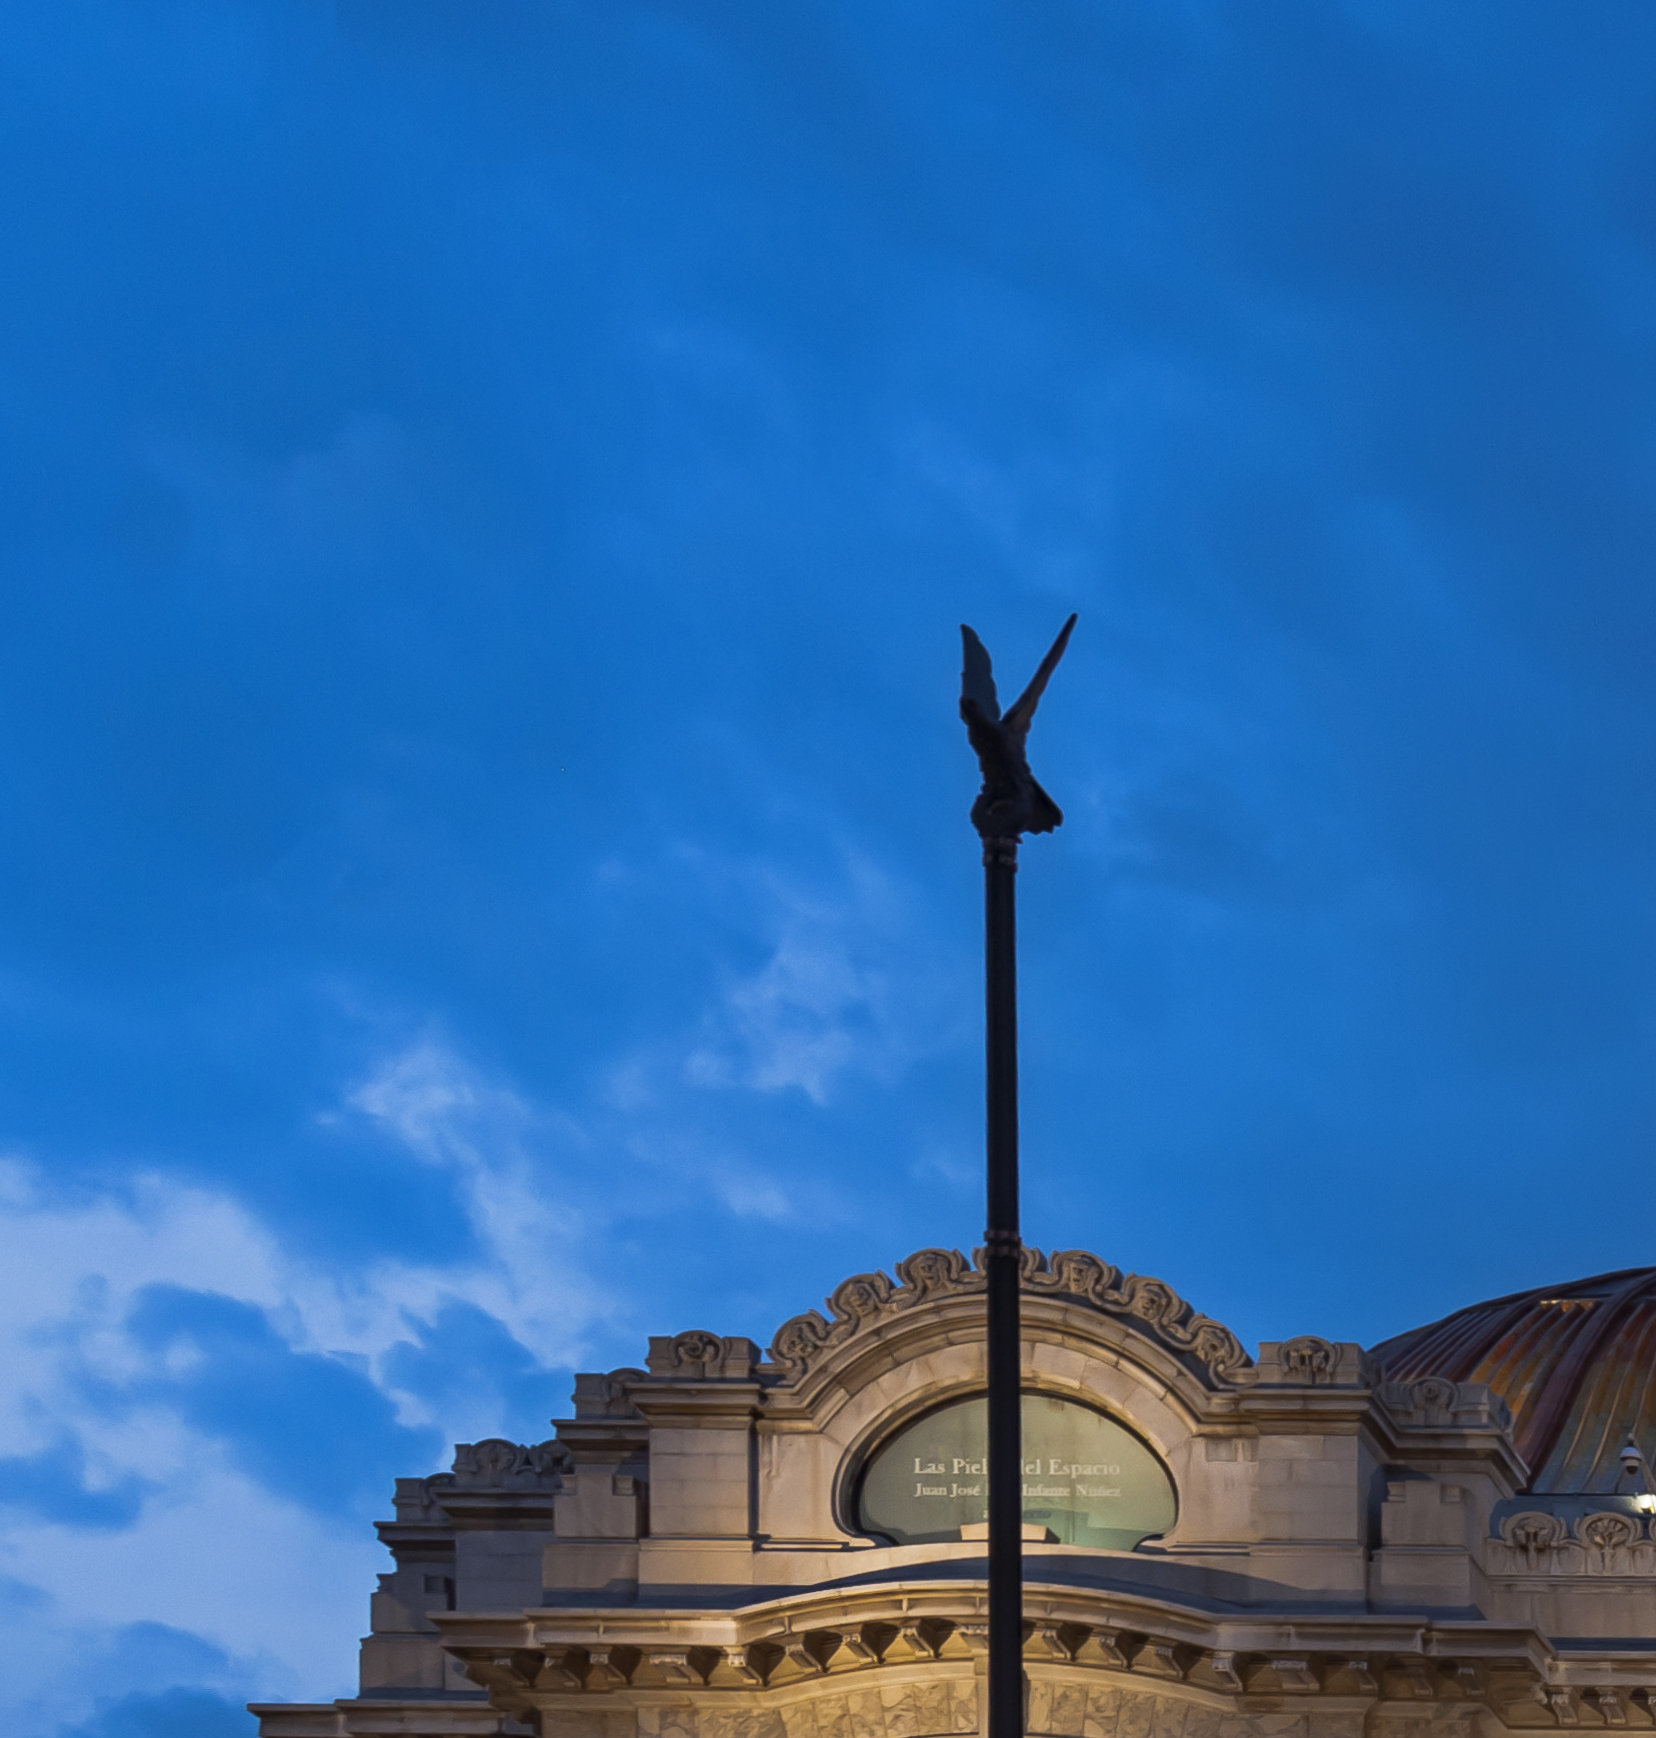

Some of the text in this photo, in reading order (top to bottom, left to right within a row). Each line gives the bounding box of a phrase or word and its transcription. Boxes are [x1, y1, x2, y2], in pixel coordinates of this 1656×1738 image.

[914, 1457, 1120, 1479] Las Piel el Espacio
[914, 1483, 948, 1498] Juan
[949, 1483, 982, 1499] José
[1022, 1483, 1071, 1498] Infante
